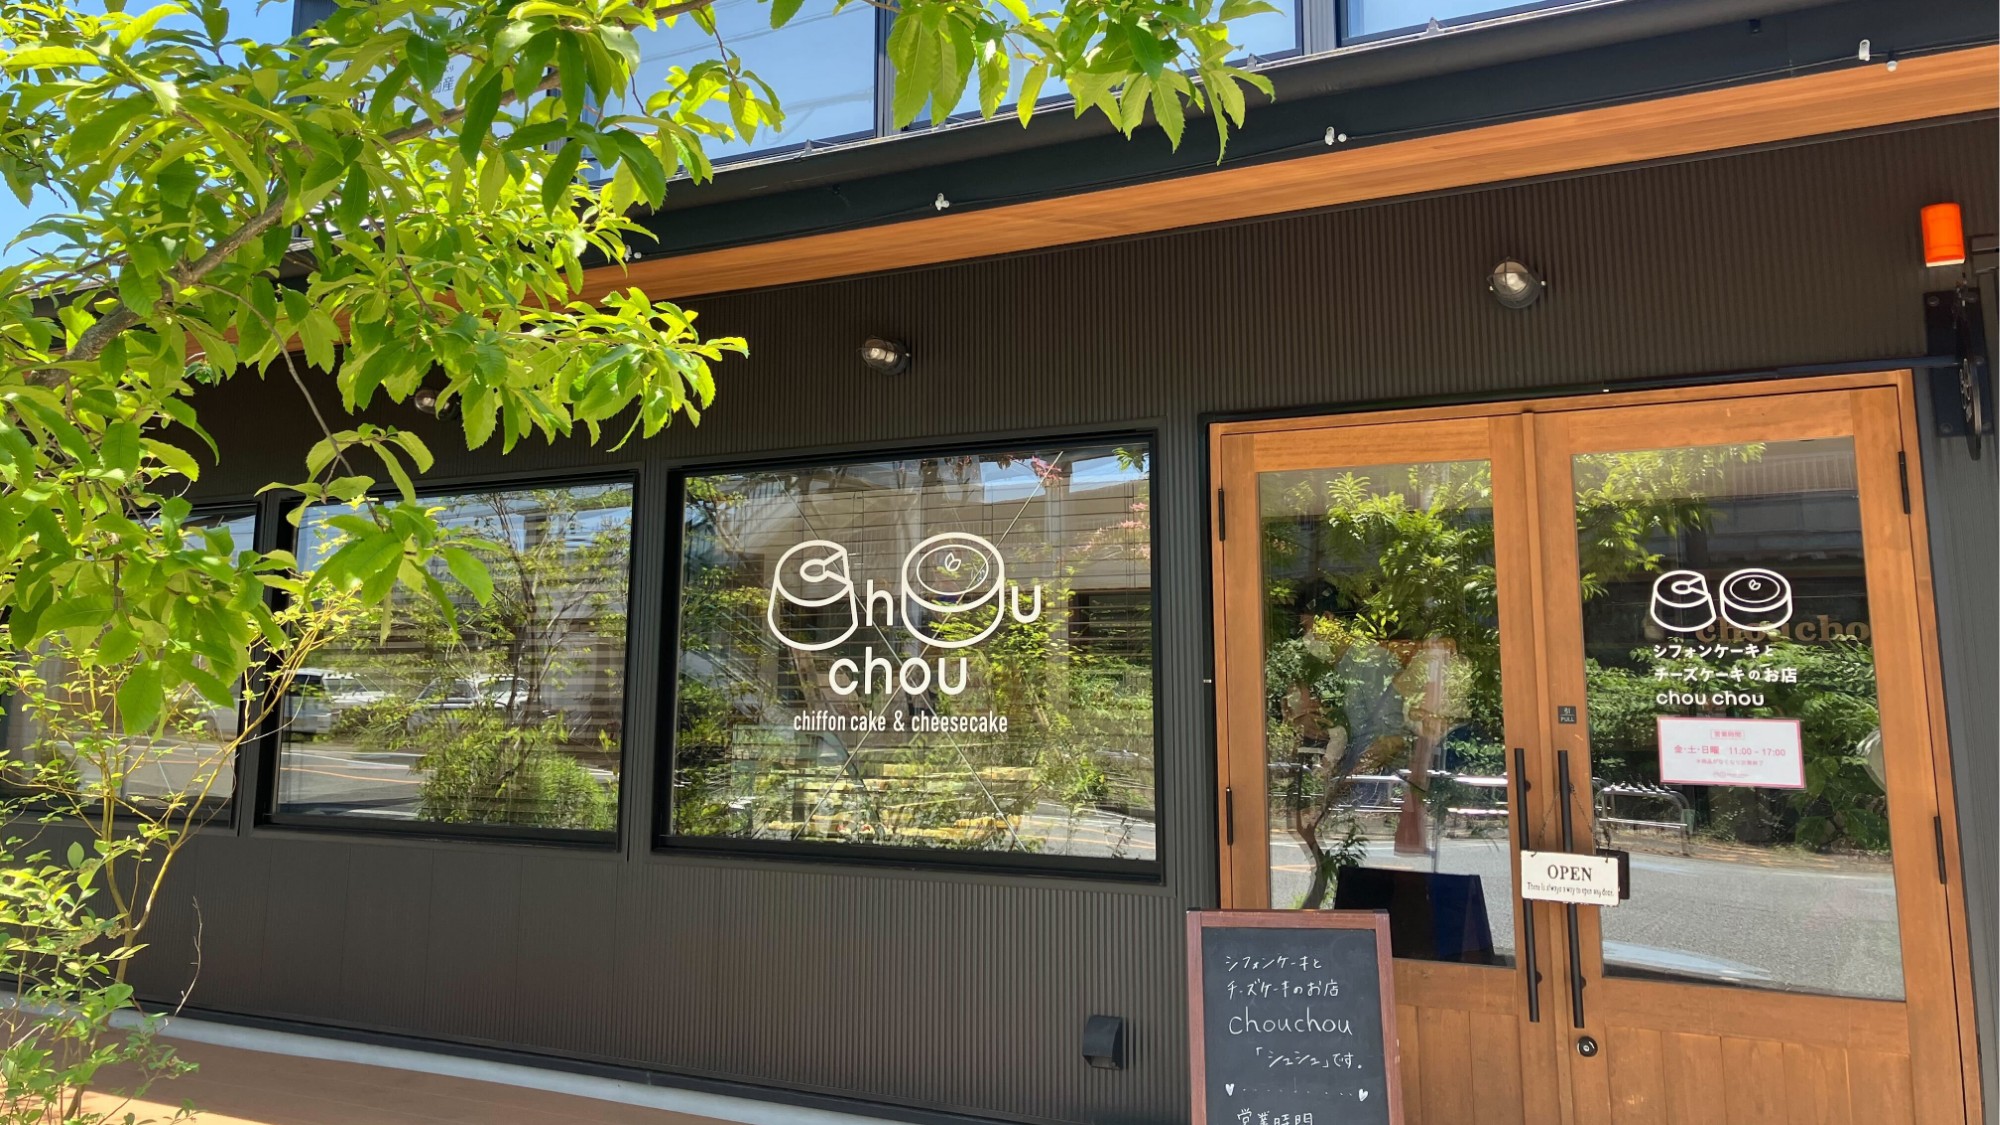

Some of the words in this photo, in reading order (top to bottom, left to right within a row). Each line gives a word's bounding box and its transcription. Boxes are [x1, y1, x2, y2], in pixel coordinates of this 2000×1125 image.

[1653, 643, 1774, 659] シフォンケーキと
[828, 646, 967, 695] chou
[1653, 667, 1798, 684] チーズケーキのお店
[1656, 690, 1706, 706] chou
[1711, 690, 1765, 707] chou
[793, 710, 846, 731] chiffon
[850, 710, 886, 732] cake
[893, 711, 905, 731] &
[911, 710, 1008, 733] cheesecake
[1547, 864, 1592, 882] OPEN
[1225, 955, 1323, 972] シフォンケーキと
[1228, 1006, 1353, 1036] chouchou
